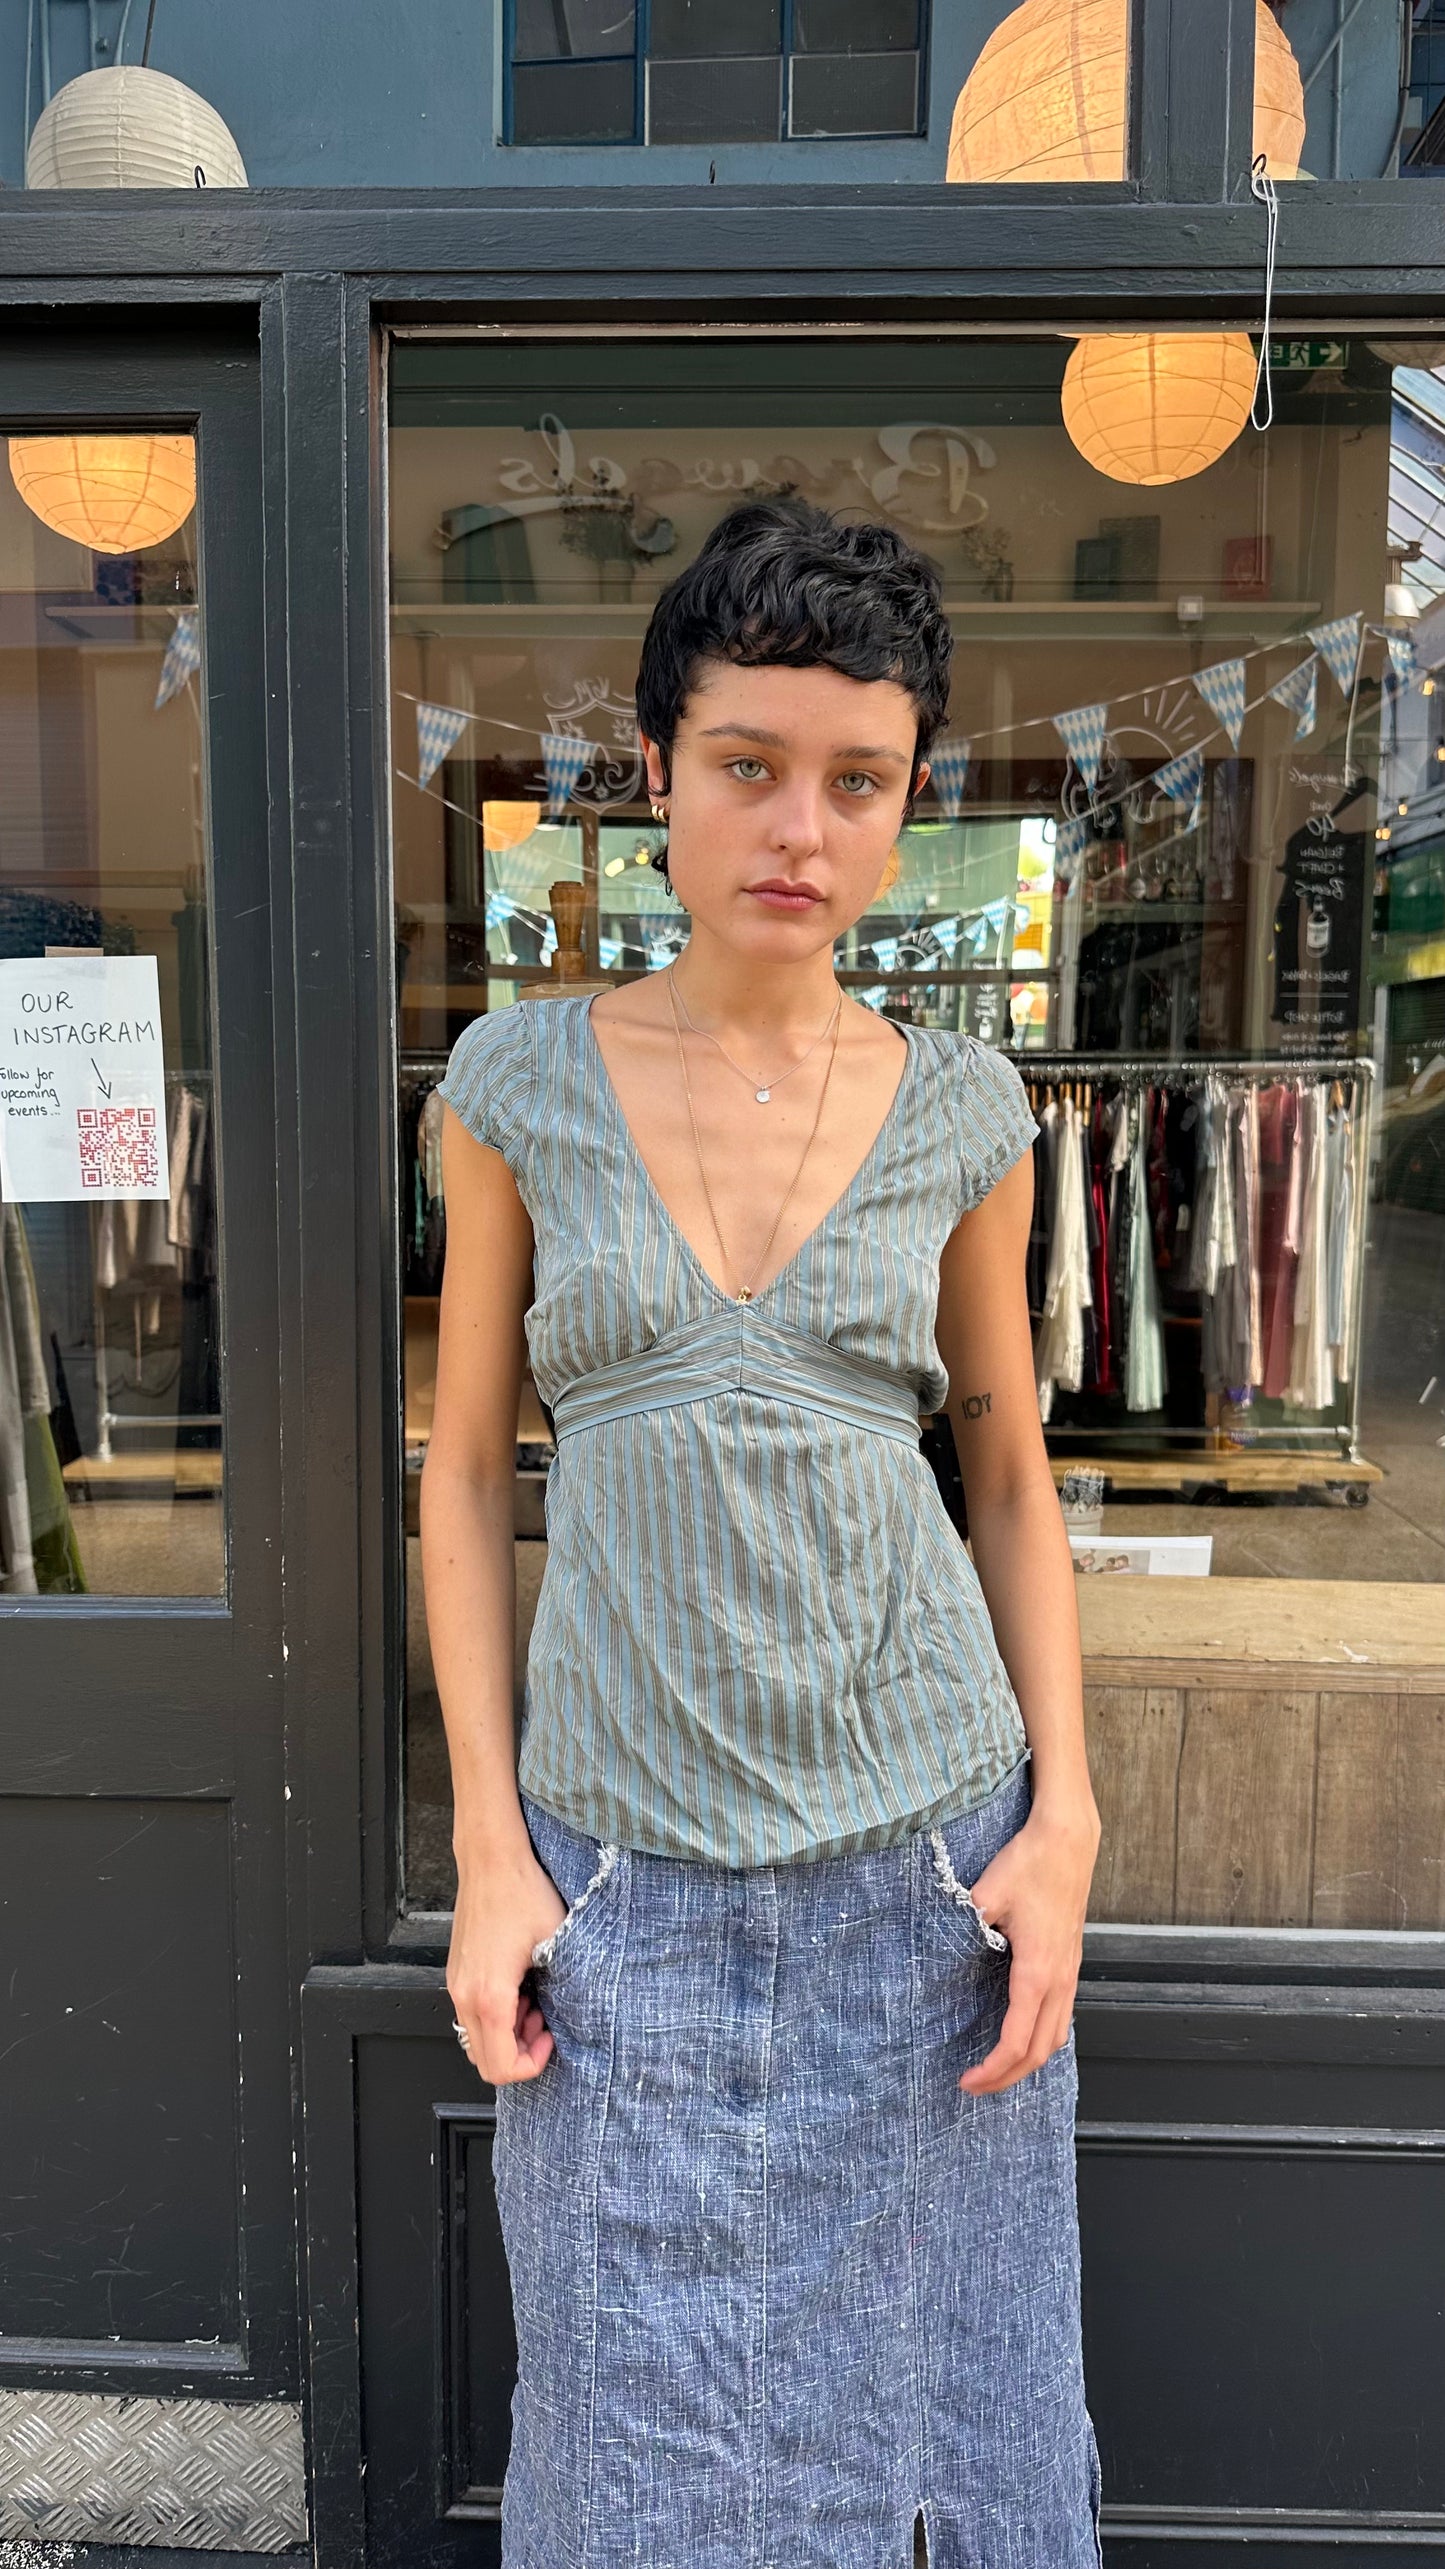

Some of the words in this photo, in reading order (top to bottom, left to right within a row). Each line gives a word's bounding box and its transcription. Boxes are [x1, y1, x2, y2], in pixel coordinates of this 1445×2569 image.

[21, 991, 73, 1013] OUR
[13, 1020, 155, 1045] INSTAGRAM
[34, 1067, 55, 1089] for
[1, 1088, 60, 1107] upcoming
